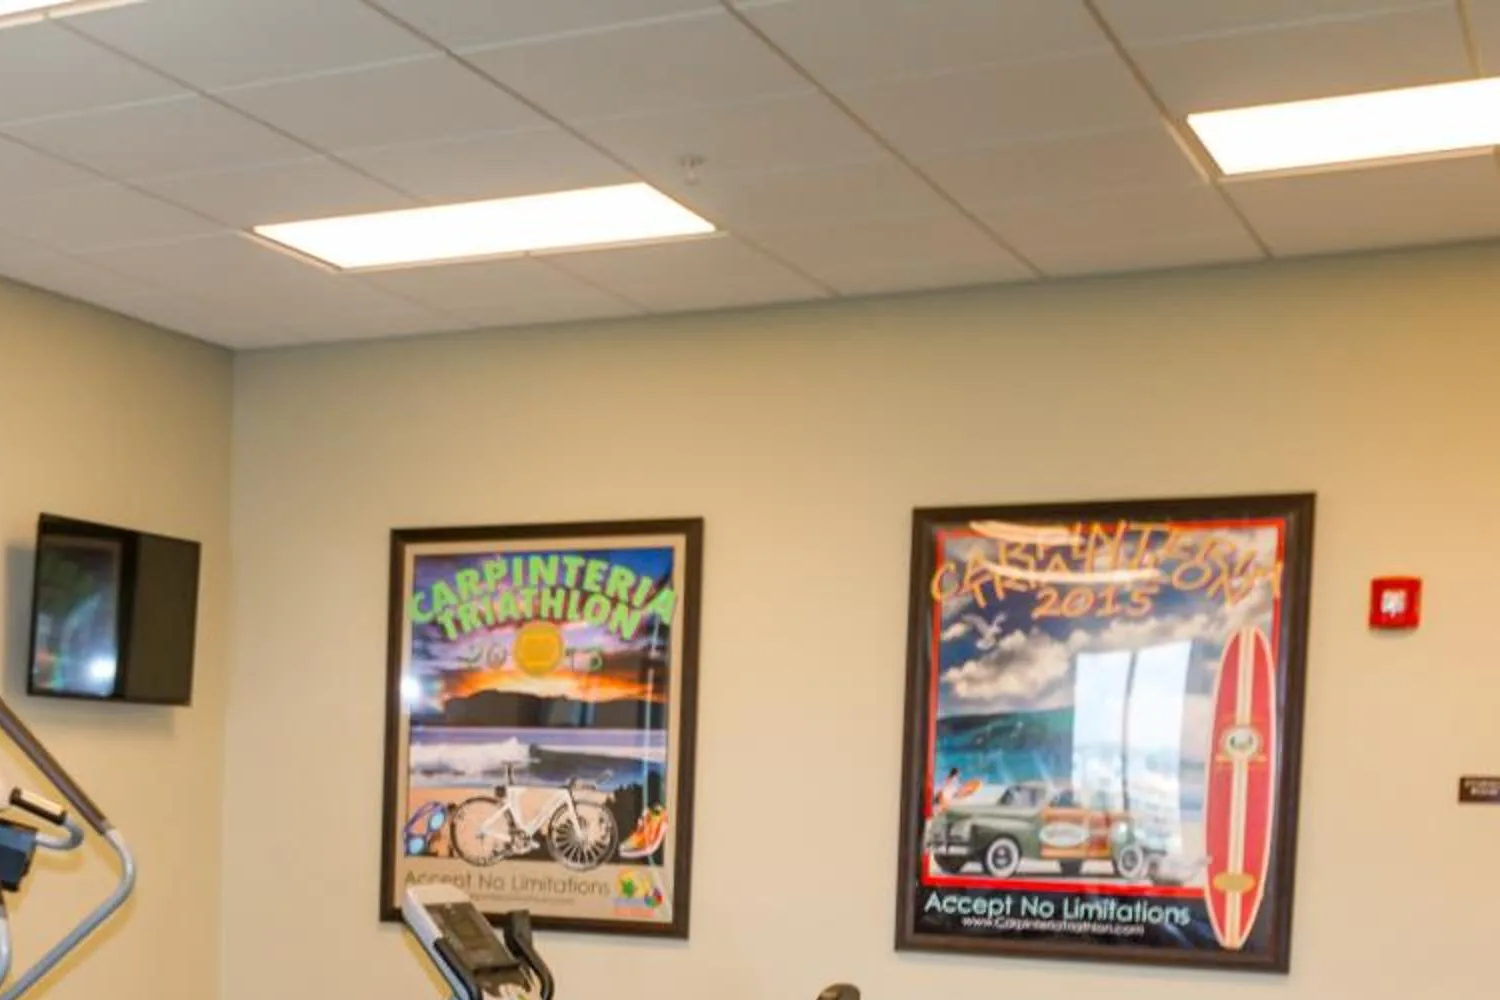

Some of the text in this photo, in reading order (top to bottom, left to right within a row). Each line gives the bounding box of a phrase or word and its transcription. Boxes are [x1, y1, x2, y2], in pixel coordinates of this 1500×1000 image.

[408, 555, 678, 624] CARPINTERIA
[972, 552, 1257, 608] TRIALON
[1031, 585, 1158, 619] 2015
[437, 586, 642, 641] TRIATHLON
[403, 869, 611, 897] Accept No Limitations
[924, 890, 1191, 926] Accept No Limitations
